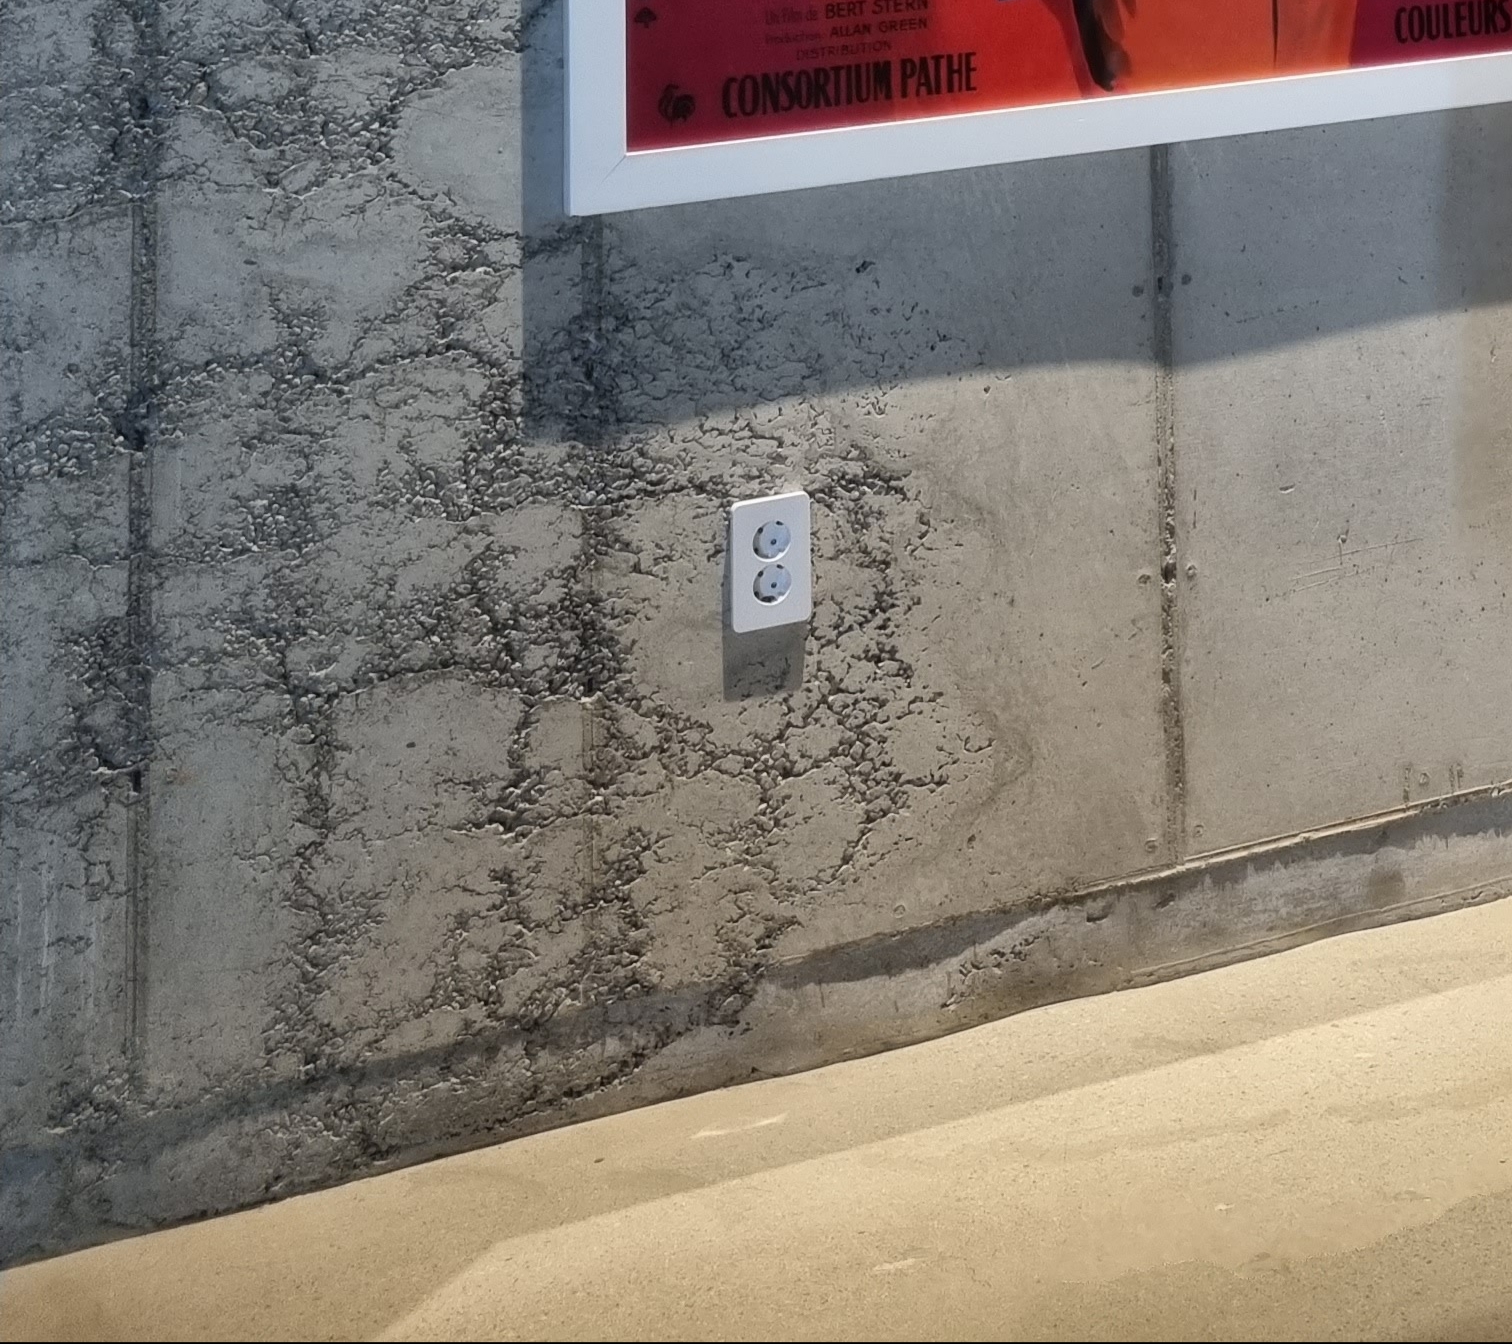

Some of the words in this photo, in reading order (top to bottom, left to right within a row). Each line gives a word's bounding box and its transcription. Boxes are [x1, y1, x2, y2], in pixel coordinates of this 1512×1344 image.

[825, 0, 866, 19] BERT
[830, 24, 871, 37] ALLAN
[878, 17, 927, 32] GREEN
[796, 41, 891, 60] DISTRIBUTION
[721, 58, 892, 119] CONSORTIUM
[901, 52, 977, 99] PATHE
